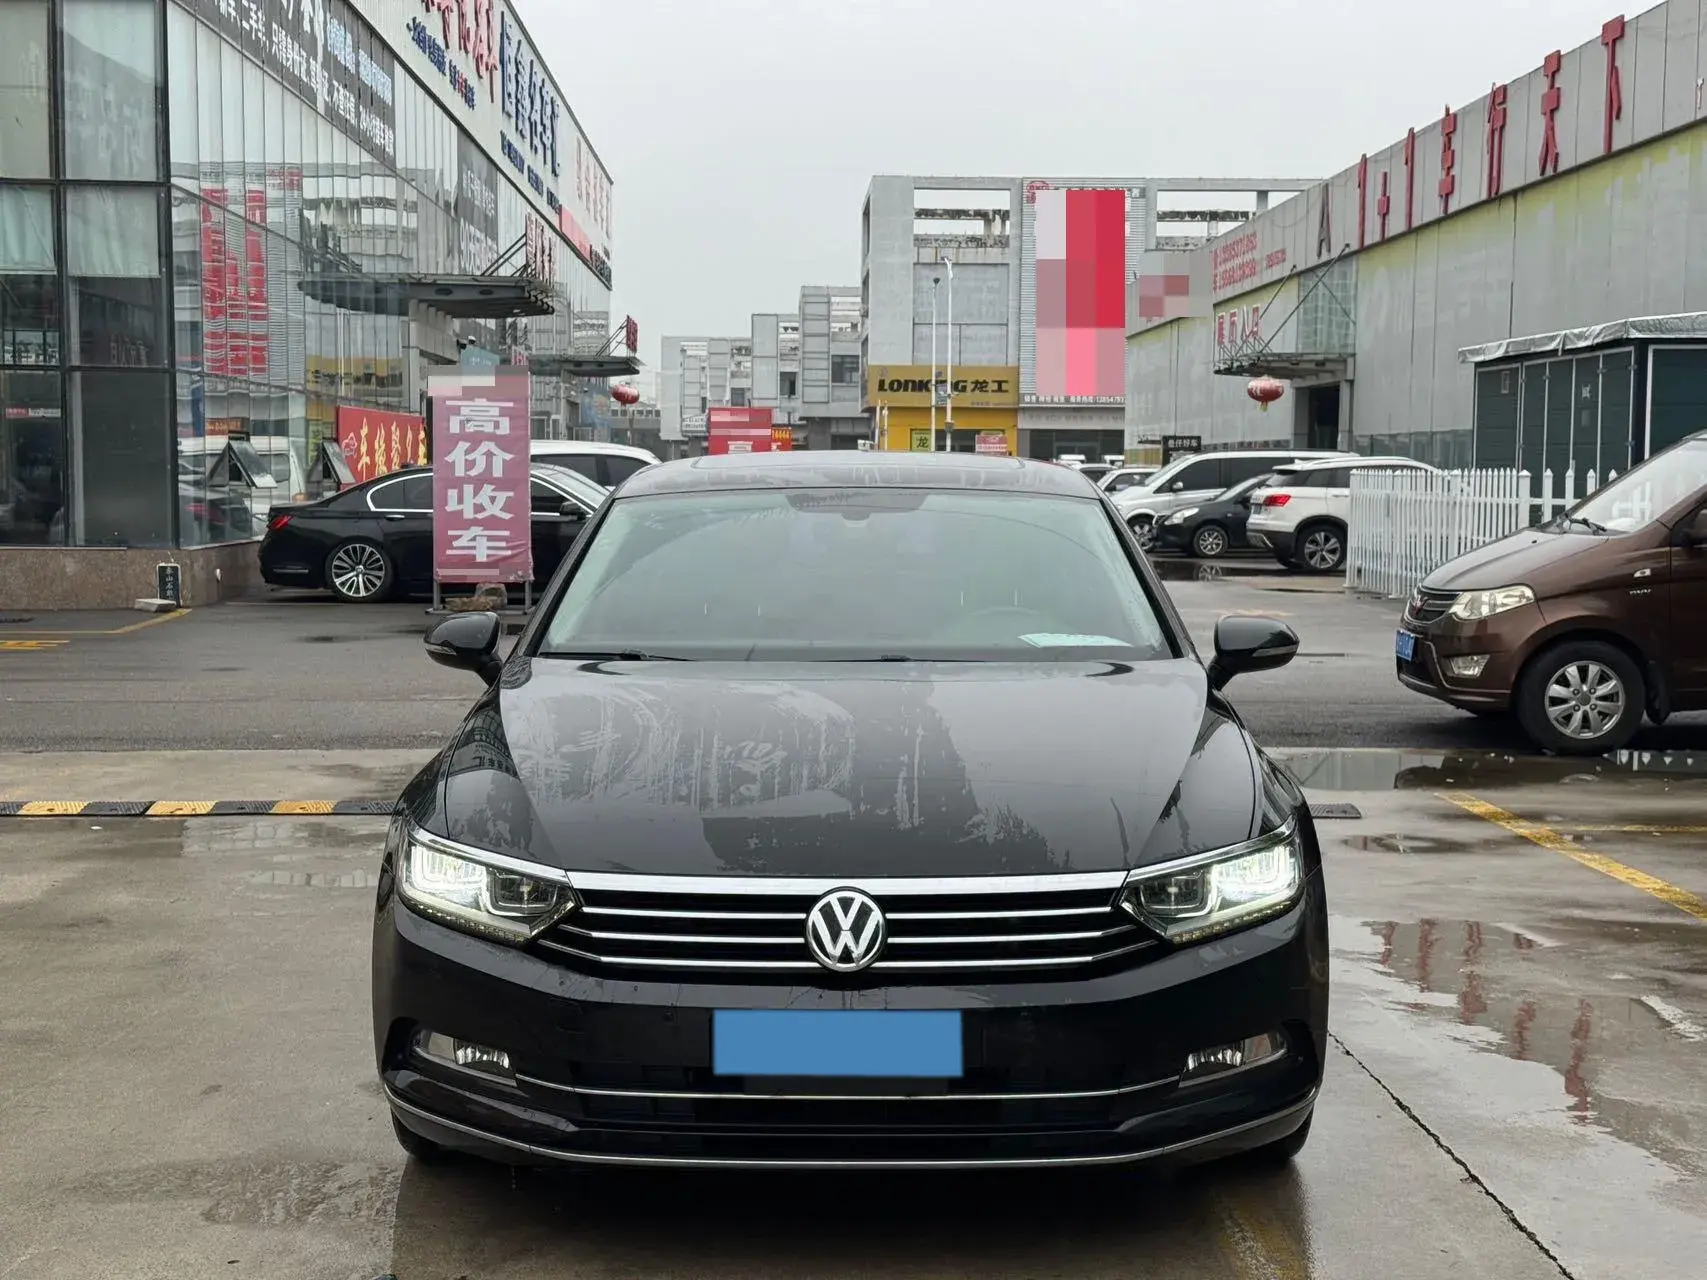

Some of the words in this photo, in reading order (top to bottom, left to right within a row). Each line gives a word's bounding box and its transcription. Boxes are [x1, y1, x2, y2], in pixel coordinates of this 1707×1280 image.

[877, 378, 968, 393] LONKG
[970, 379, 1009, 393] 龙工
[444, 397, 515, 562] 高价收车
